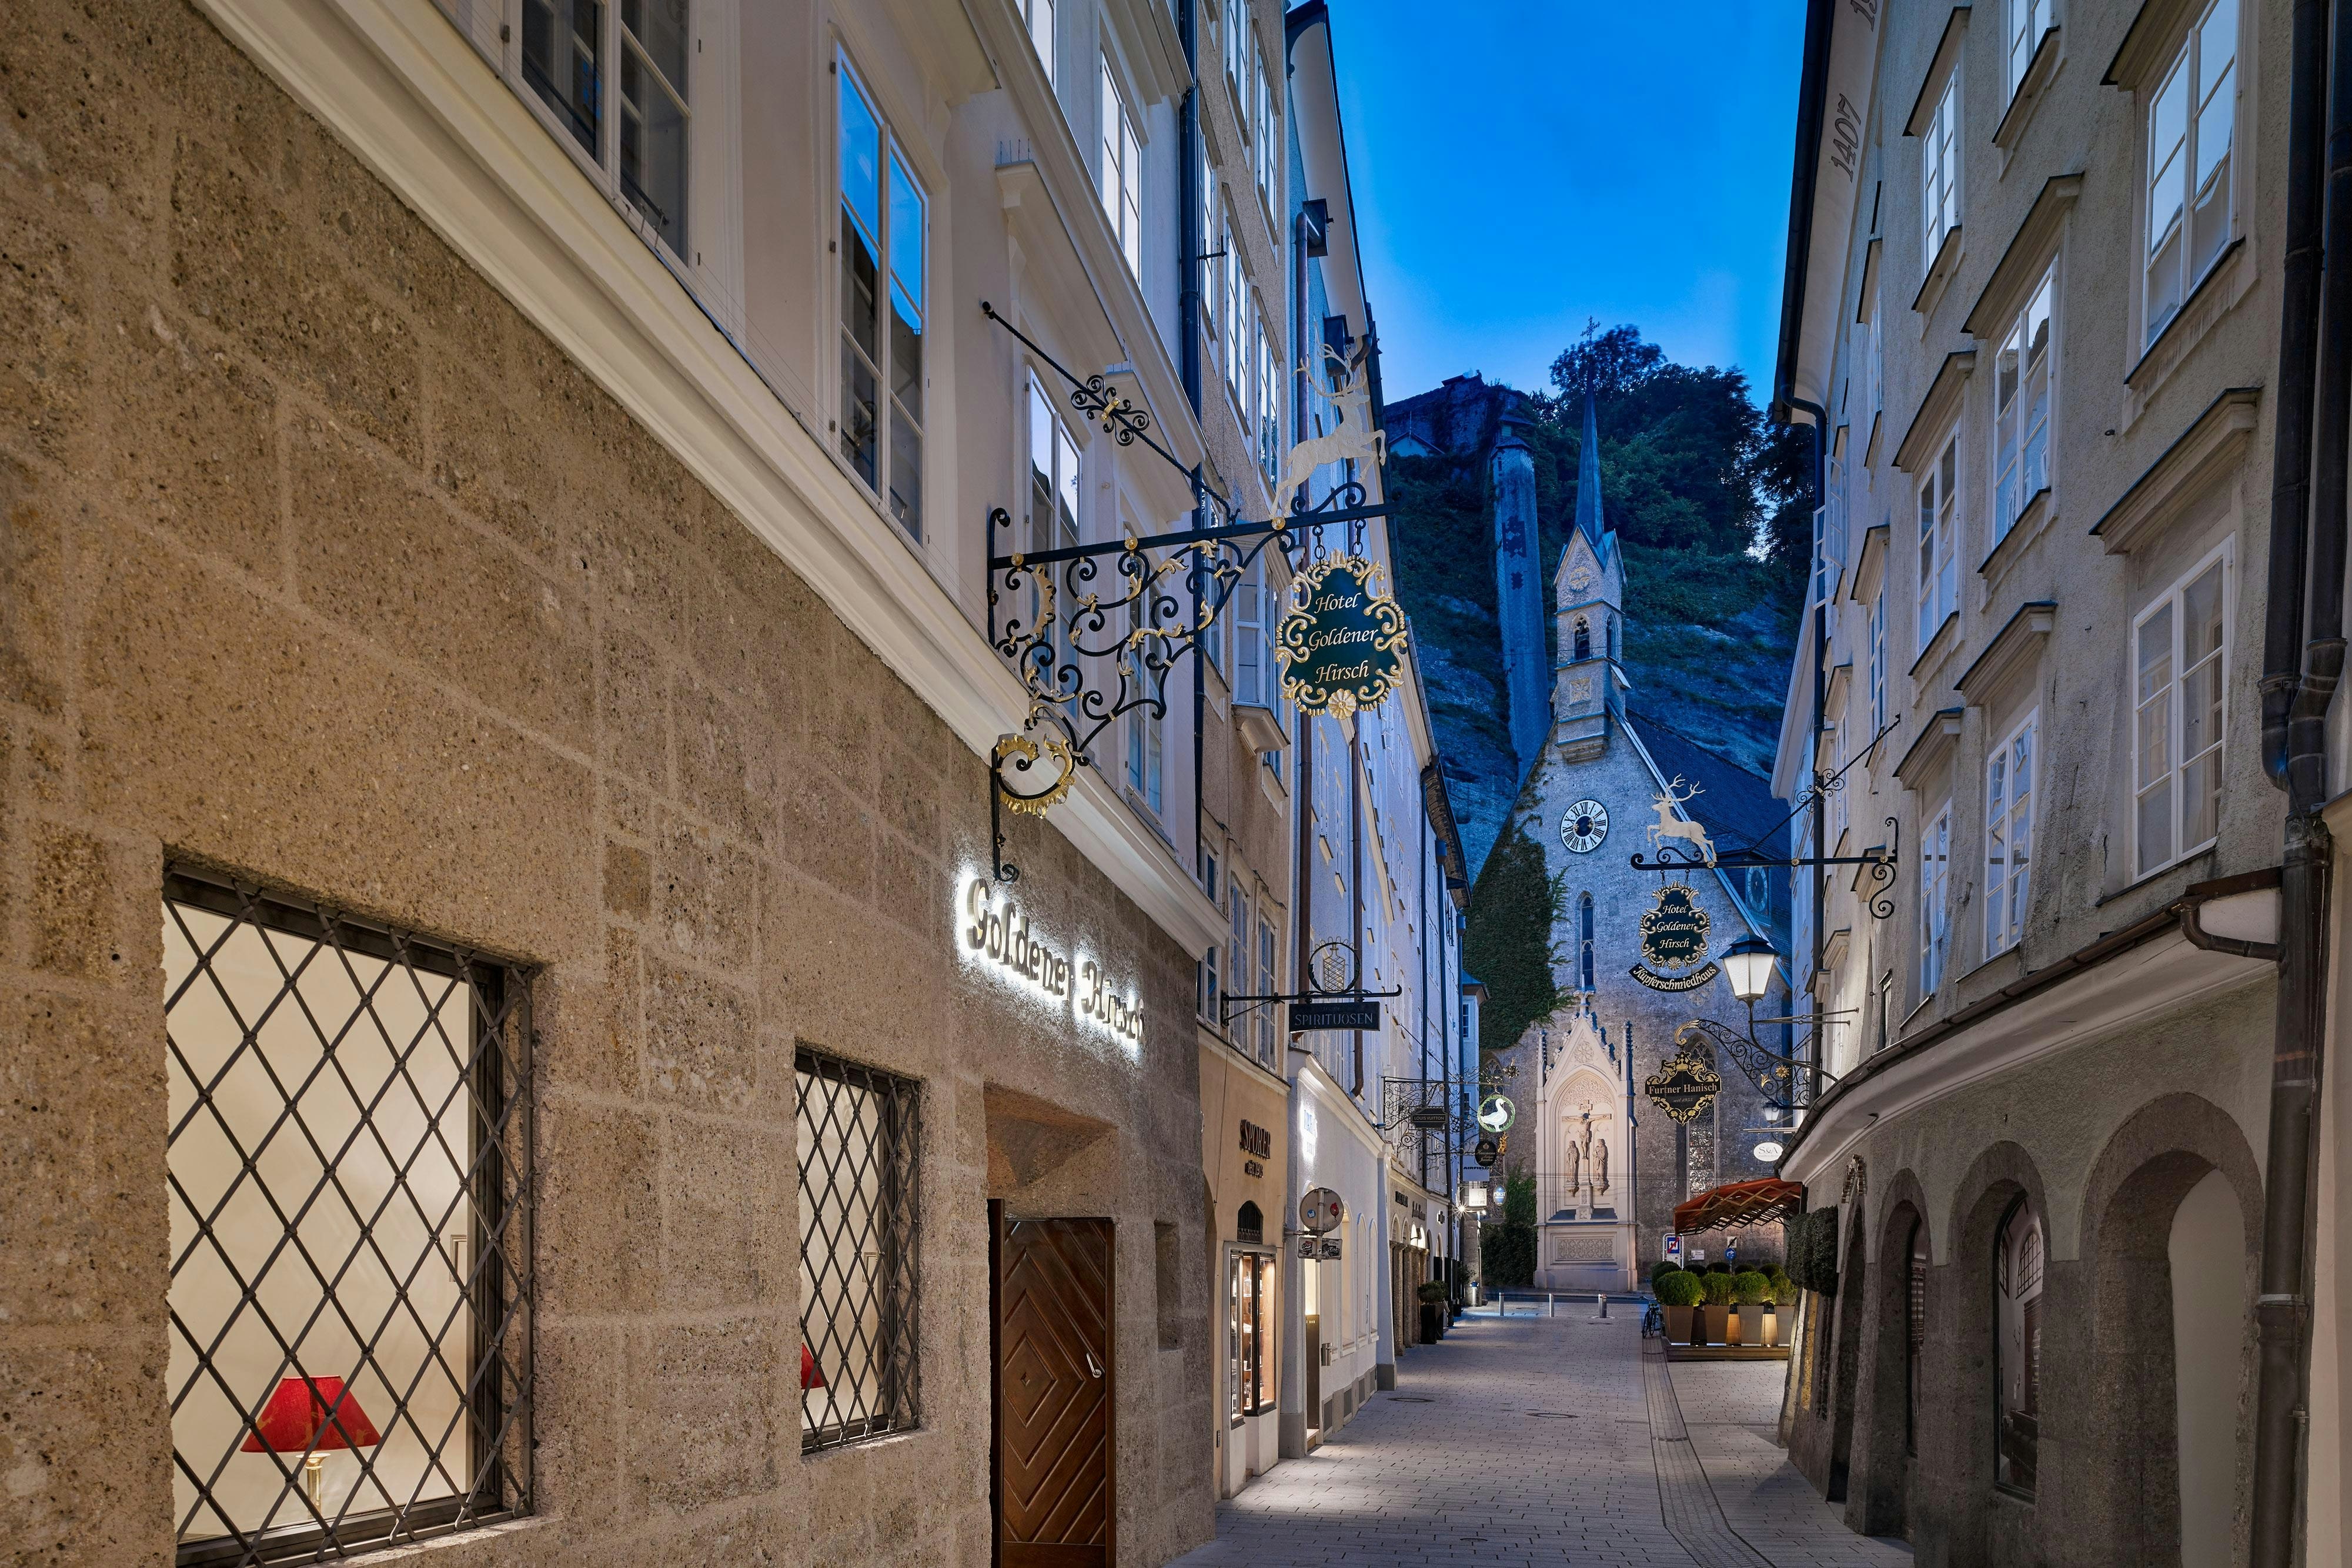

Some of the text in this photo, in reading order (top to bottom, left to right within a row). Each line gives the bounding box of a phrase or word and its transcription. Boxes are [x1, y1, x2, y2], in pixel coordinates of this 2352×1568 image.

[1831, 93, 1861, 183] 1407
[1314, 592, 1362, 614] Hotel
[1308, 627, 1378, 651] Goldener
[1315, 660, 1369, 684] Hirsch
[1662, 904, 1689, 915] Hotel
[1656, 921, 1696, 932] Goldener
[1659, 939, 1689, 949] Hirsch
[966, 878, 1145, 1040] Goldener Hirsch
[1633, 966, 1716, 990] Kupferschmiedhaus
[1295, 1012, 1373, 1026] SPIRITUOSEN
[1649, 1083, 1717, 1094] Furtner Hanisch
[1240, 1119, 1270, 1159] SPORER
